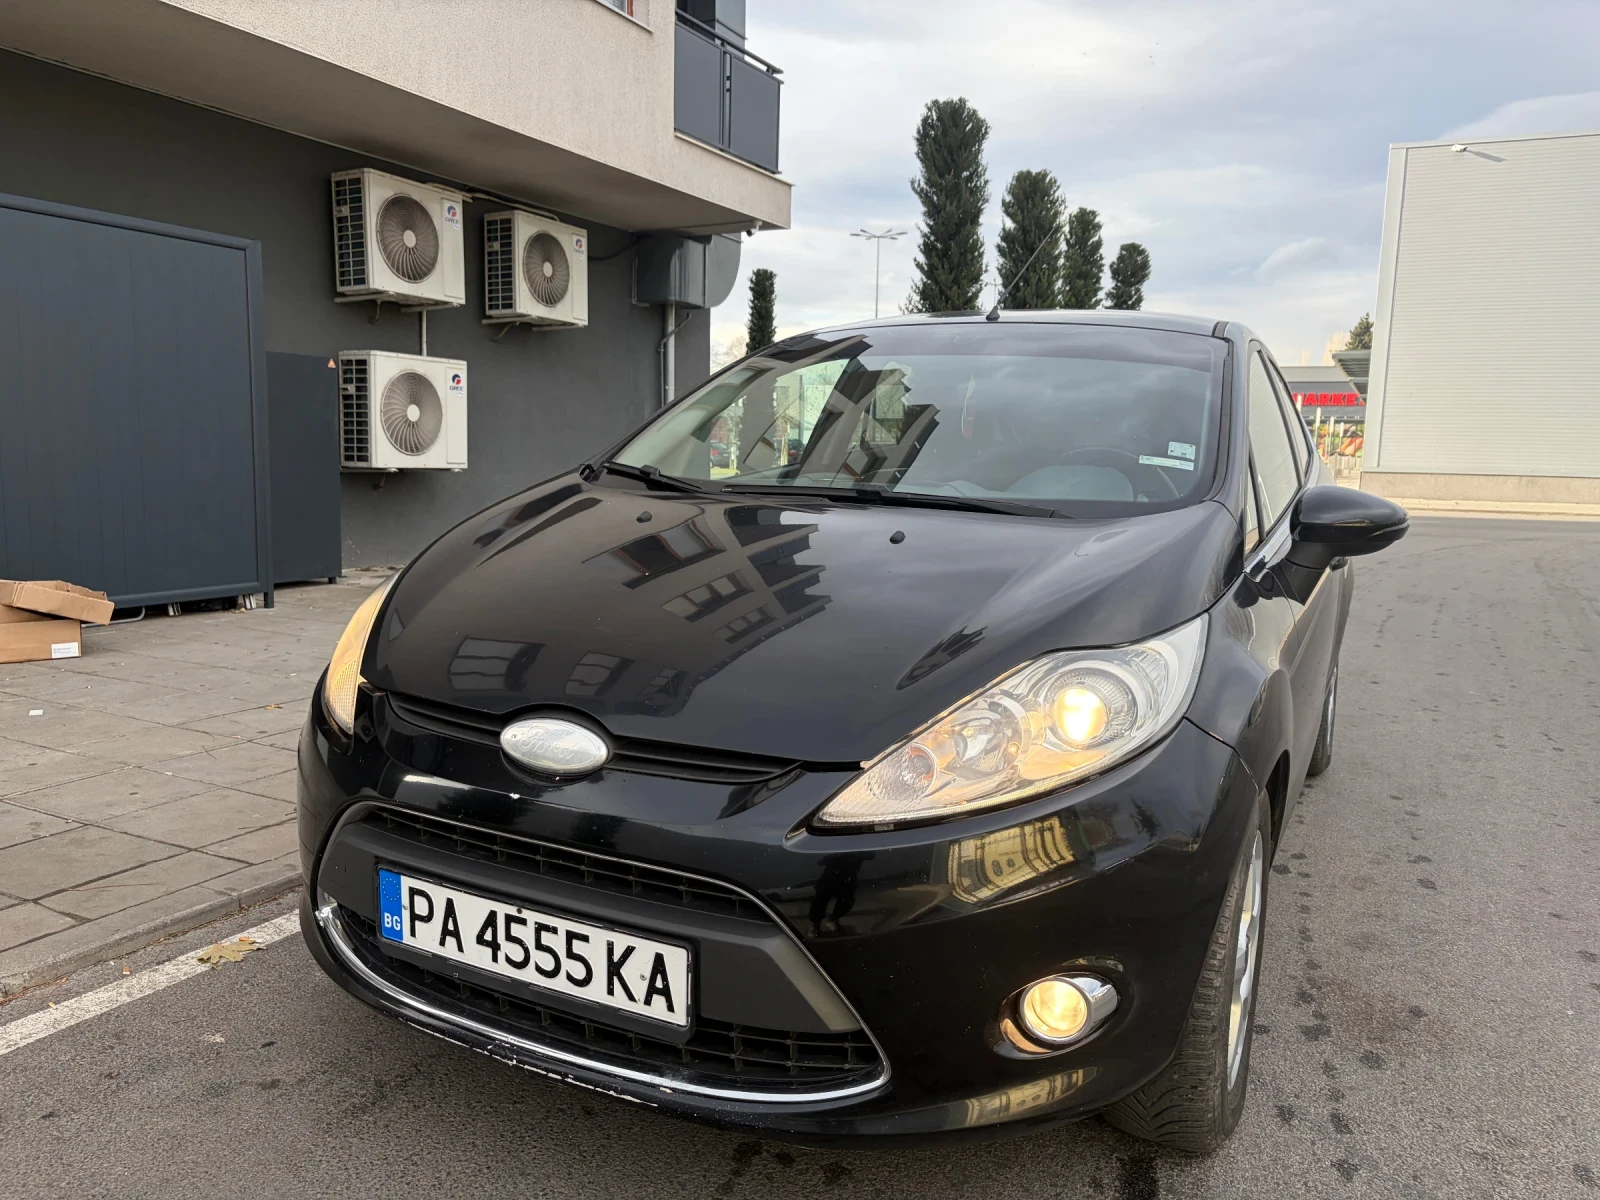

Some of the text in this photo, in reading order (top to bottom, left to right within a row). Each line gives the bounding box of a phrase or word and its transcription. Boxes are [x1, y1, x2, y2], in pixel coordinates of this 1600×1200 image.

[384, 912, 401, 931] BG
[409, 886, 676, 1014] PA 4555 KA
